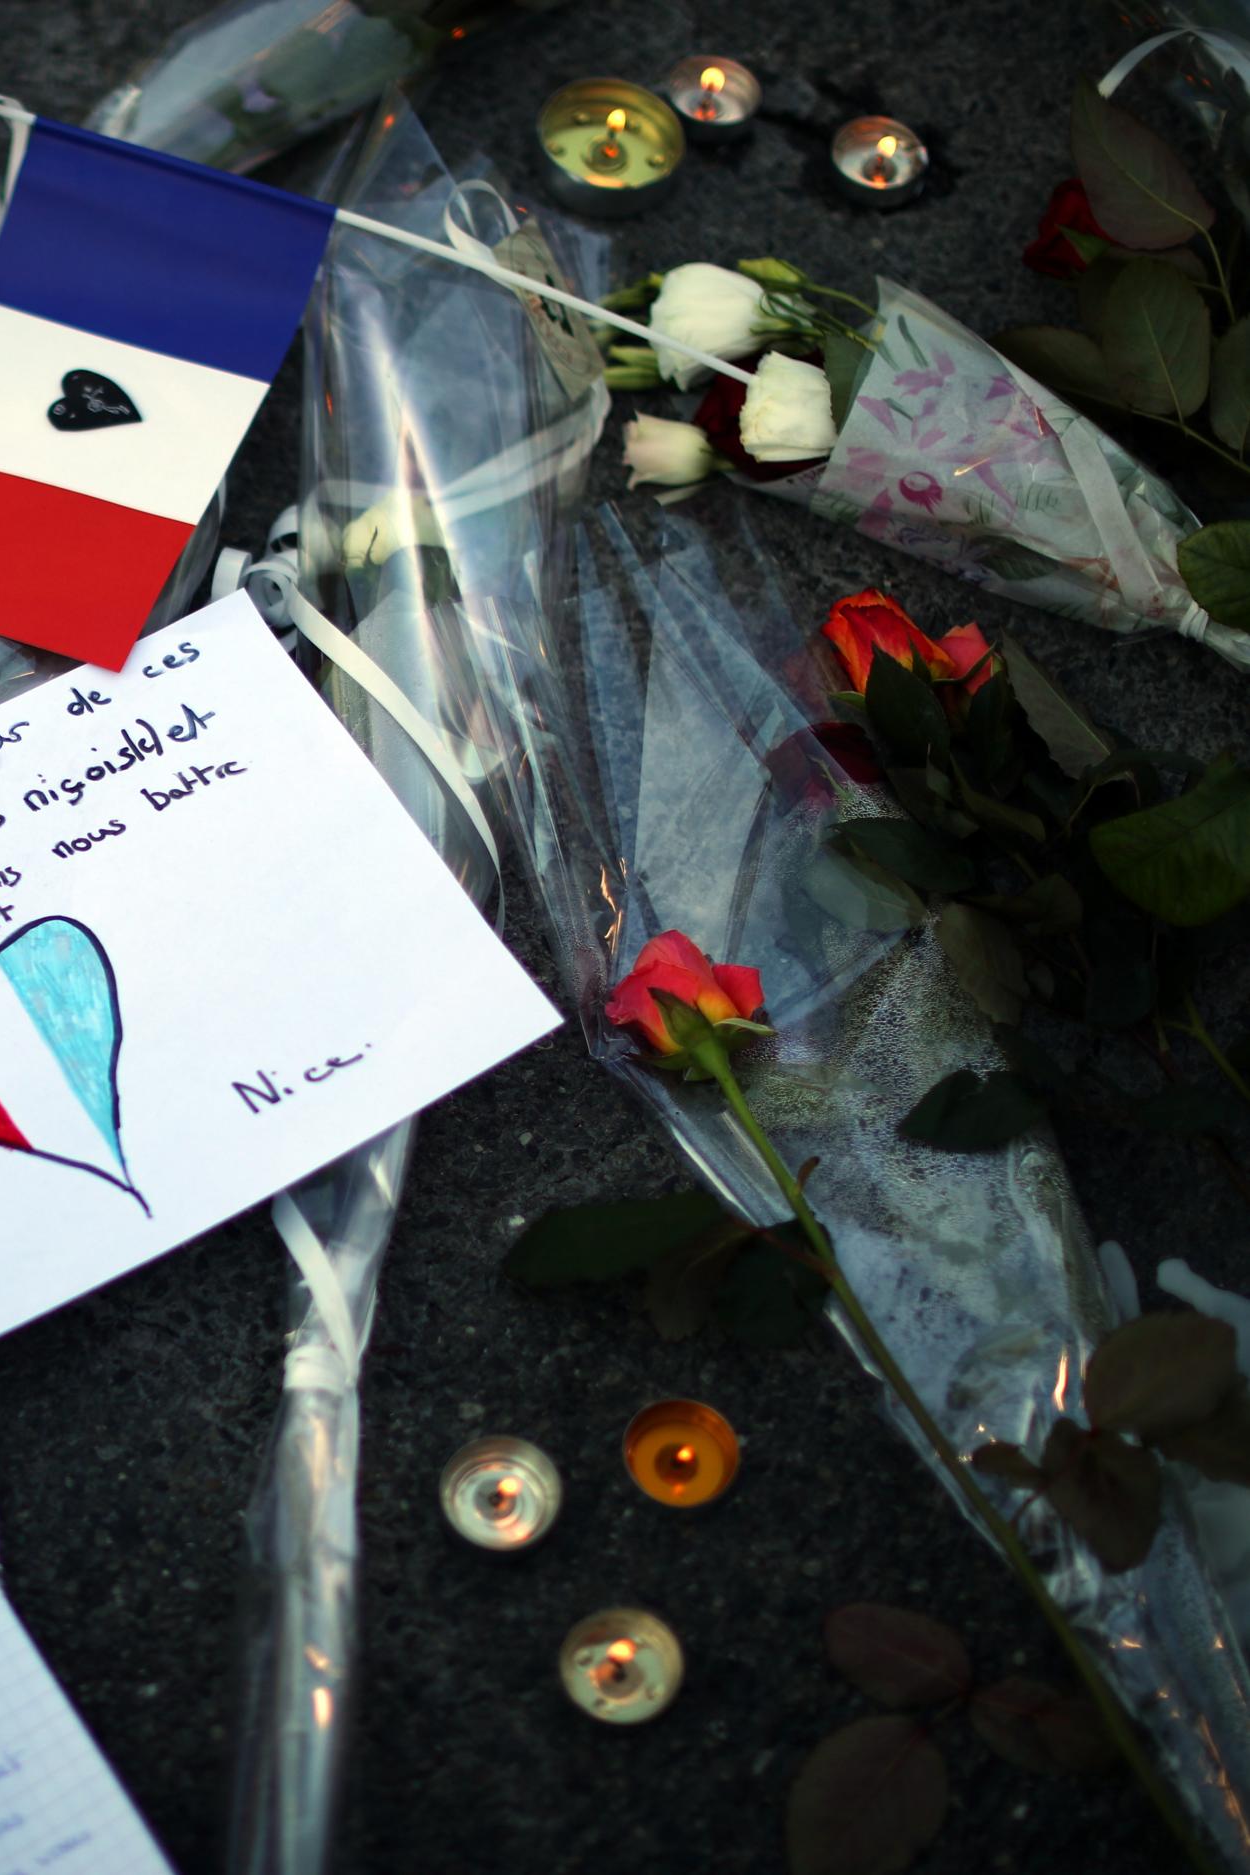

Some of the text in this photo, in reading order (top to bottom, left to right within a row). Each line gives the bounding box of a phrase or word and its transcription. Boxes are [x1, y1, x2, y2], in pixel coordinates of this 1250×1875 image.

[66, 686, 113, 717] de
[141, 641, 202, 679] ces
[166, 703, 217, 743] et
[51, 818, 128, 859] nous
[139, 760, 250, 811] battre
